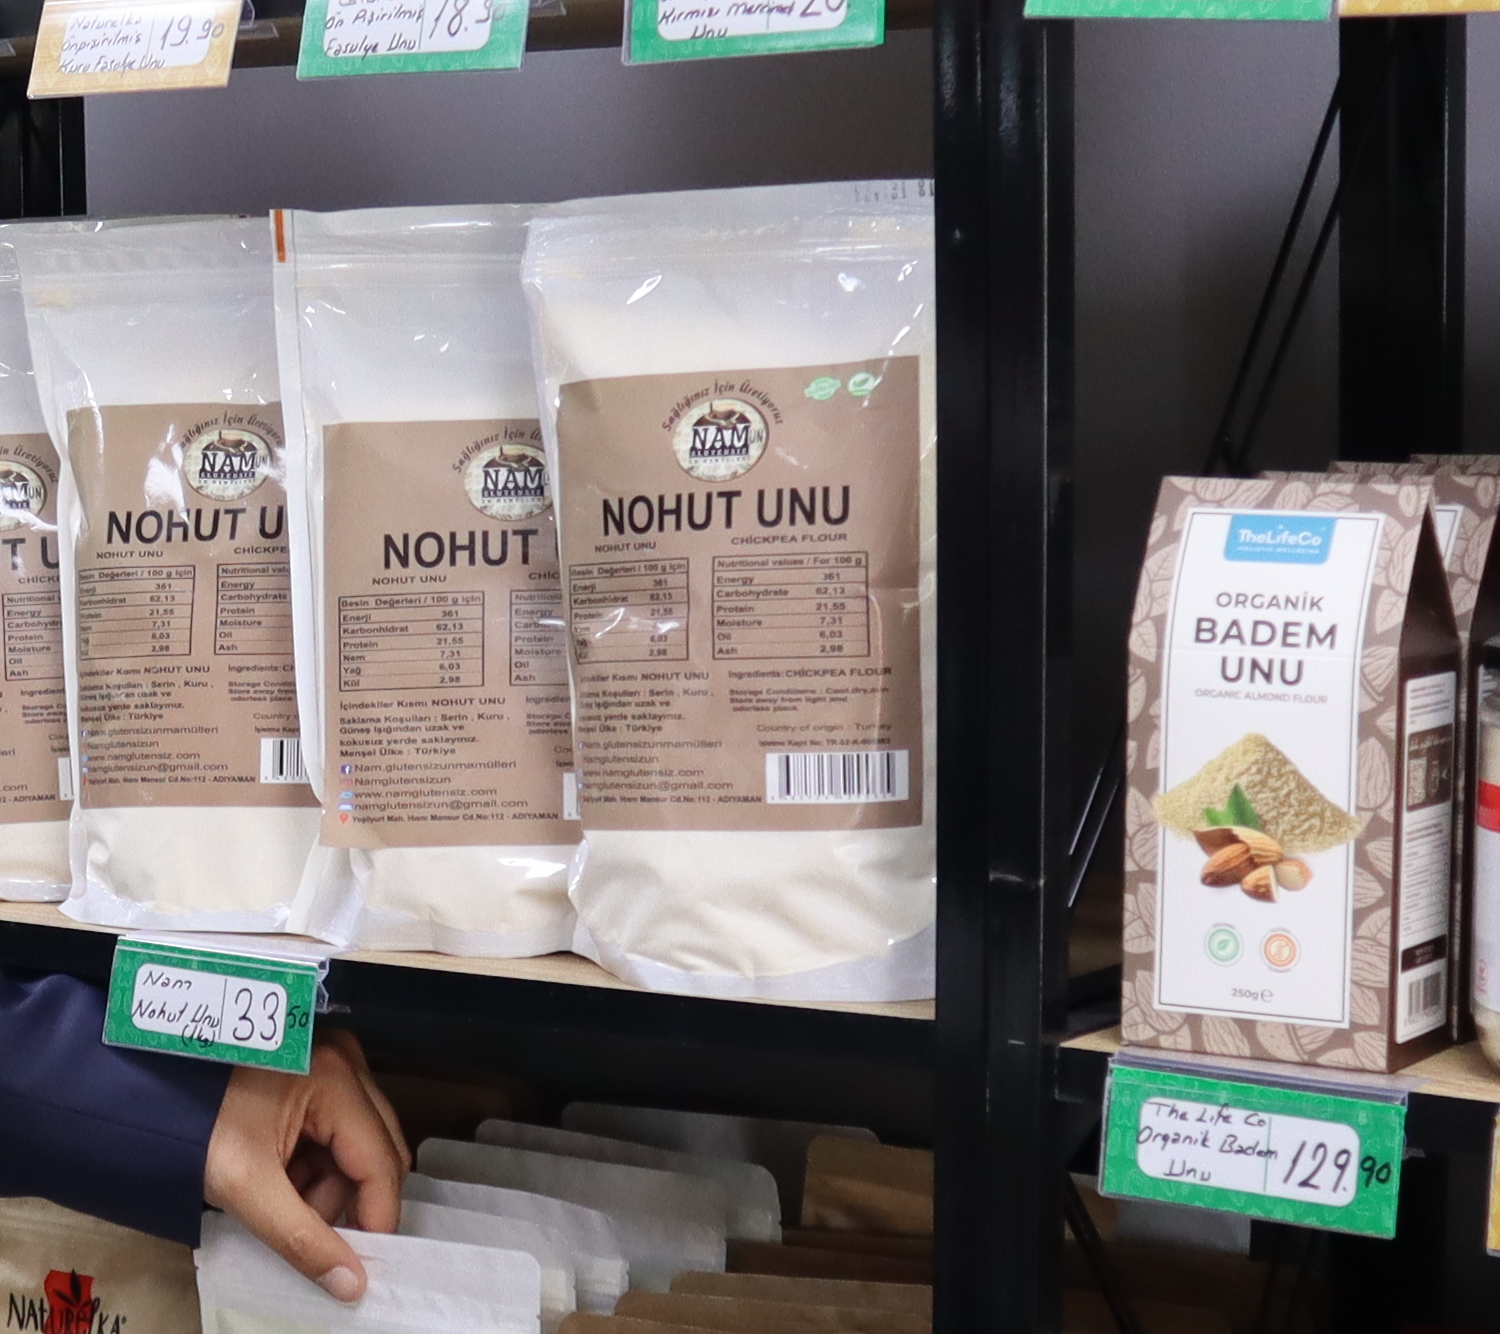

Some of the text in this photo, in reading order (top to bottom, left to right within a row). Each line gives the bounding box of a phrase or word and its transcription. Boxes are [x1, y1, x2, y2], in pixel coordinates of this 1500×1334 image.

[602, 485, 850, 536] NOHUT UNU
[106, 506, 246, 546] NOHUT
[1238, 524, 1322, 546] TheLifeCo
[634, 541, 657, 551] UNU
[801, 532, 848, 543] FLOUR
[383, 529, 538, 570] NOHUT
[372, 575, 447, 586] NOHUT UNU
[1216, 591, 1324, 612] ORGANİK
[343, 640, 378, 649] Protein
[1194, 617, 1338, 650] BADEM
[343, 654, 365, 662] Nem
[1221, 655, 1305, 686] UNU
[432, 697, 506, 707] NOHUT UNU
[1245, 692, 1290, 702] ALMOND
[1293, 694, 1328, 704] FLOUR
[131, 1001, 188, 1023] Nohut
[1148, 1101, 1190, 1123] The
[1136, 1128, 1211, 1157] Organik
